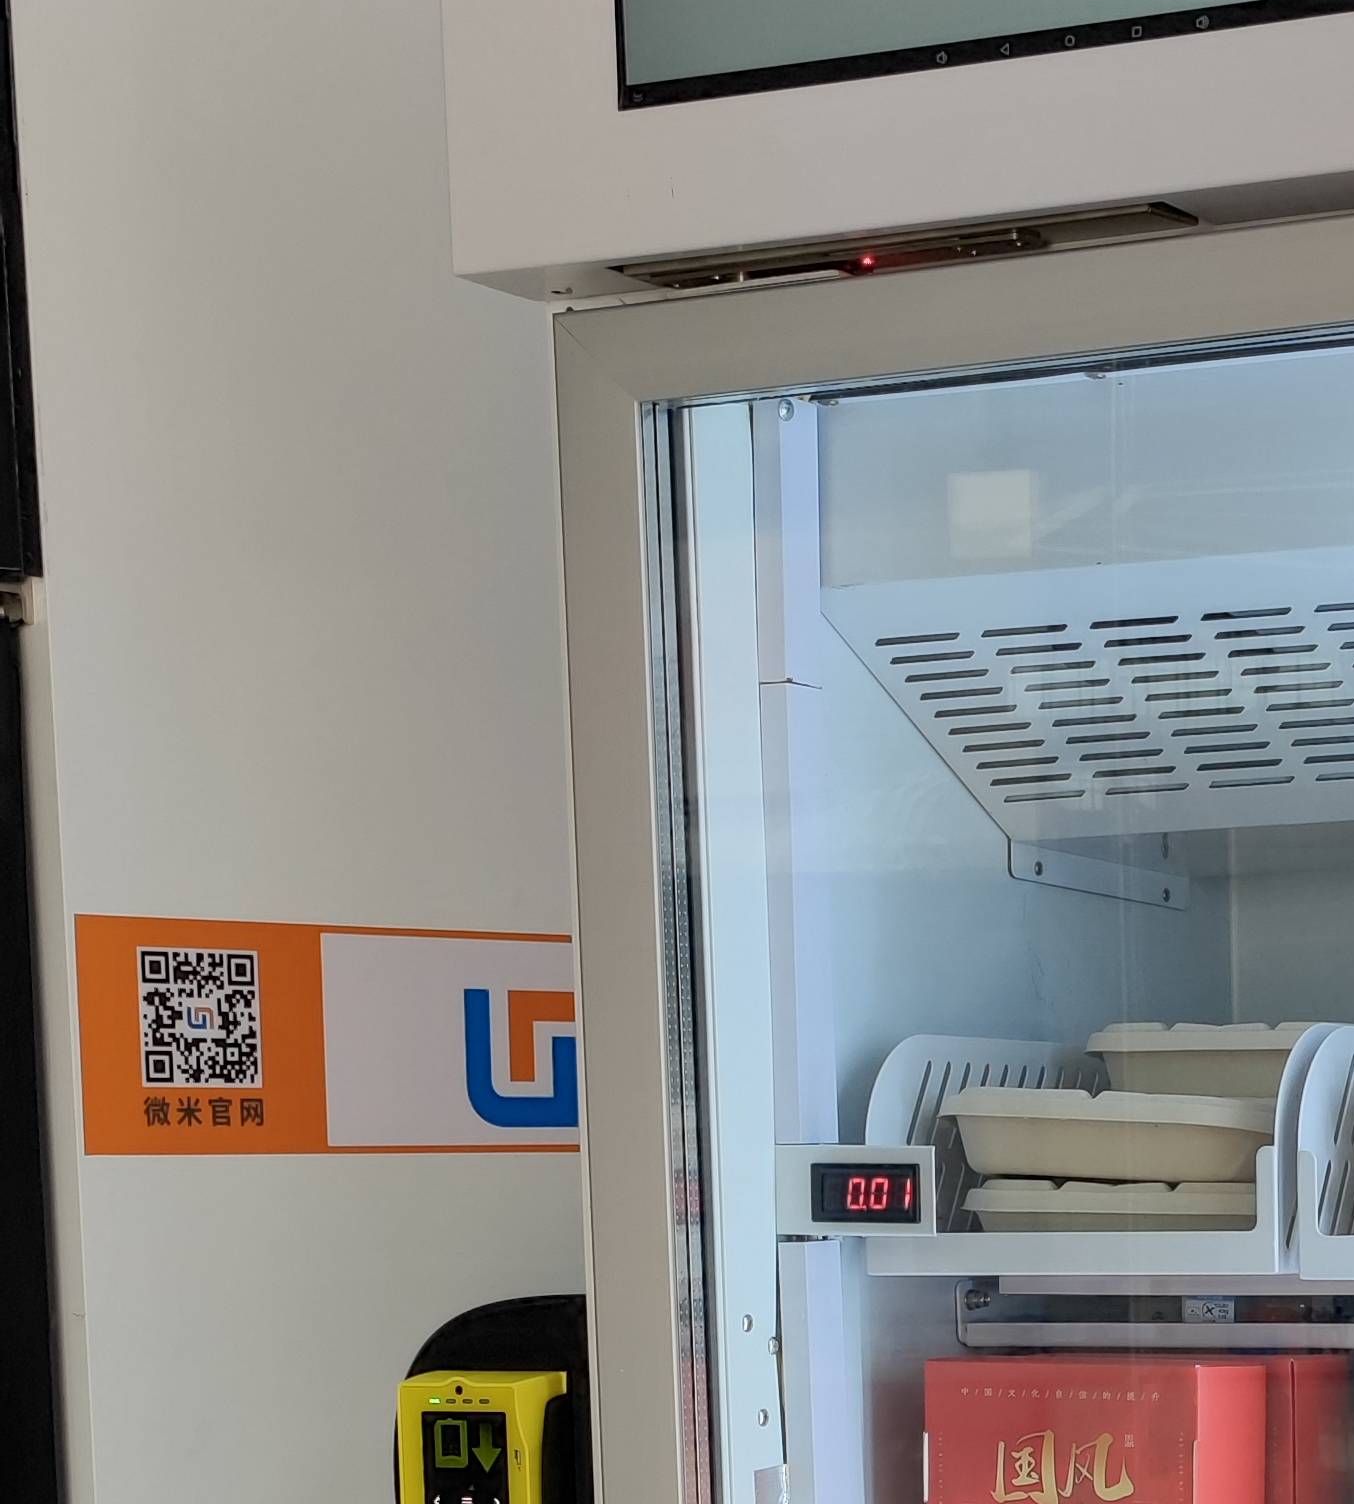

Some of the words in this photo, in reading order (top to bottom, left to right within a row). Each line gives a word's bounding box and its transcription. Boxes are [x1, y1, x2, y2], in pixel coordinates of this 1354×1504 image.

[143, 1096, 265, 1128] 微米官网
[847, 1177, 912, 1211] 0.01
